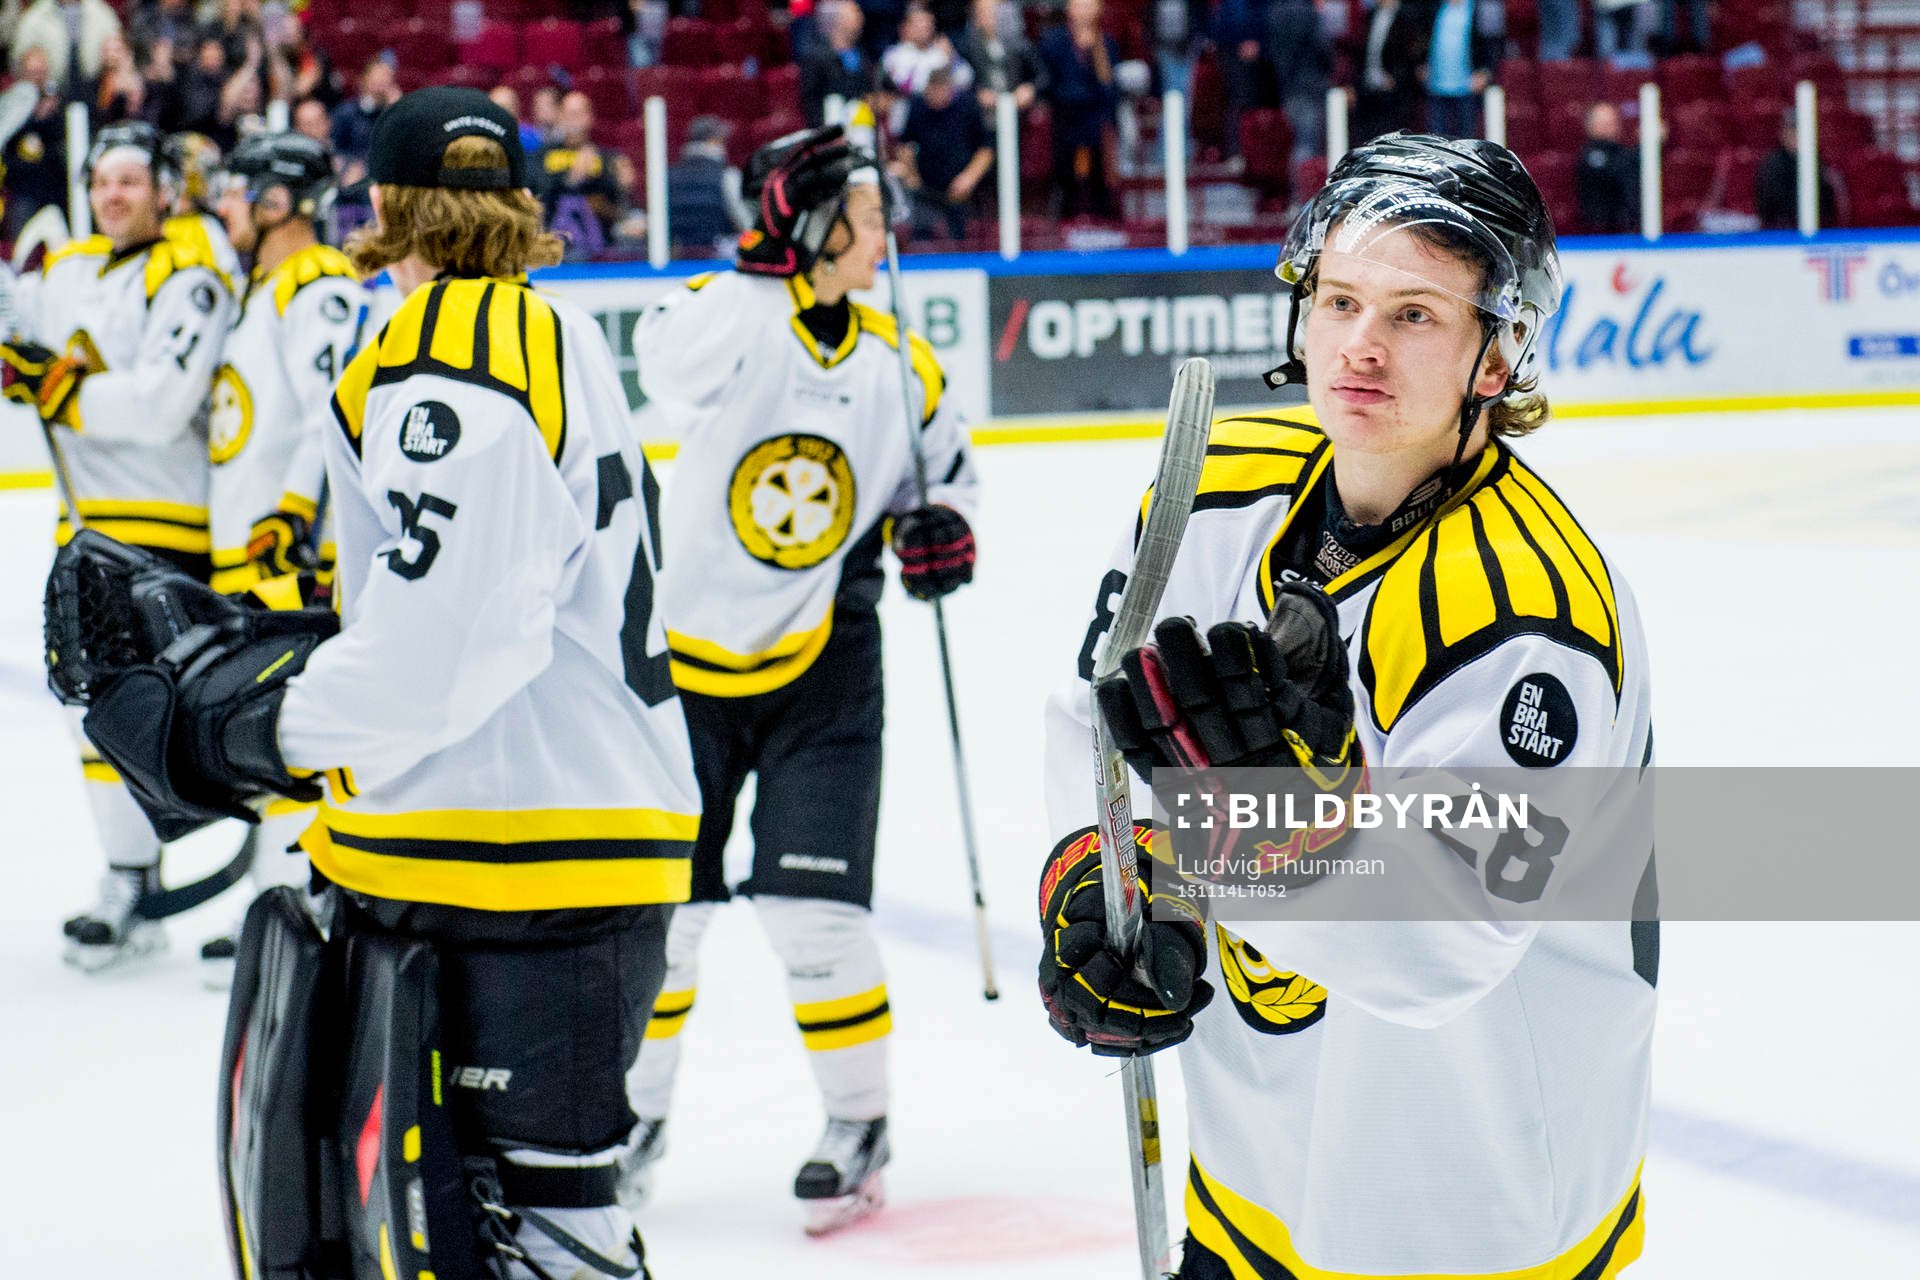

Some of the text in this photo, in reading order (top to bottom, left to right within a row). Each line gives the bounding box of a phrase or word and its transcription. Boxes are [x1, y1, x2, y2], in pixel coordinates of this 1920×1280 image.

[402, 436, 449, 456] START
[1519, 681, 1544, 709] EN
[1512, 702, 1548, 734] BRA
[1507, 723, 1564, 760] START
